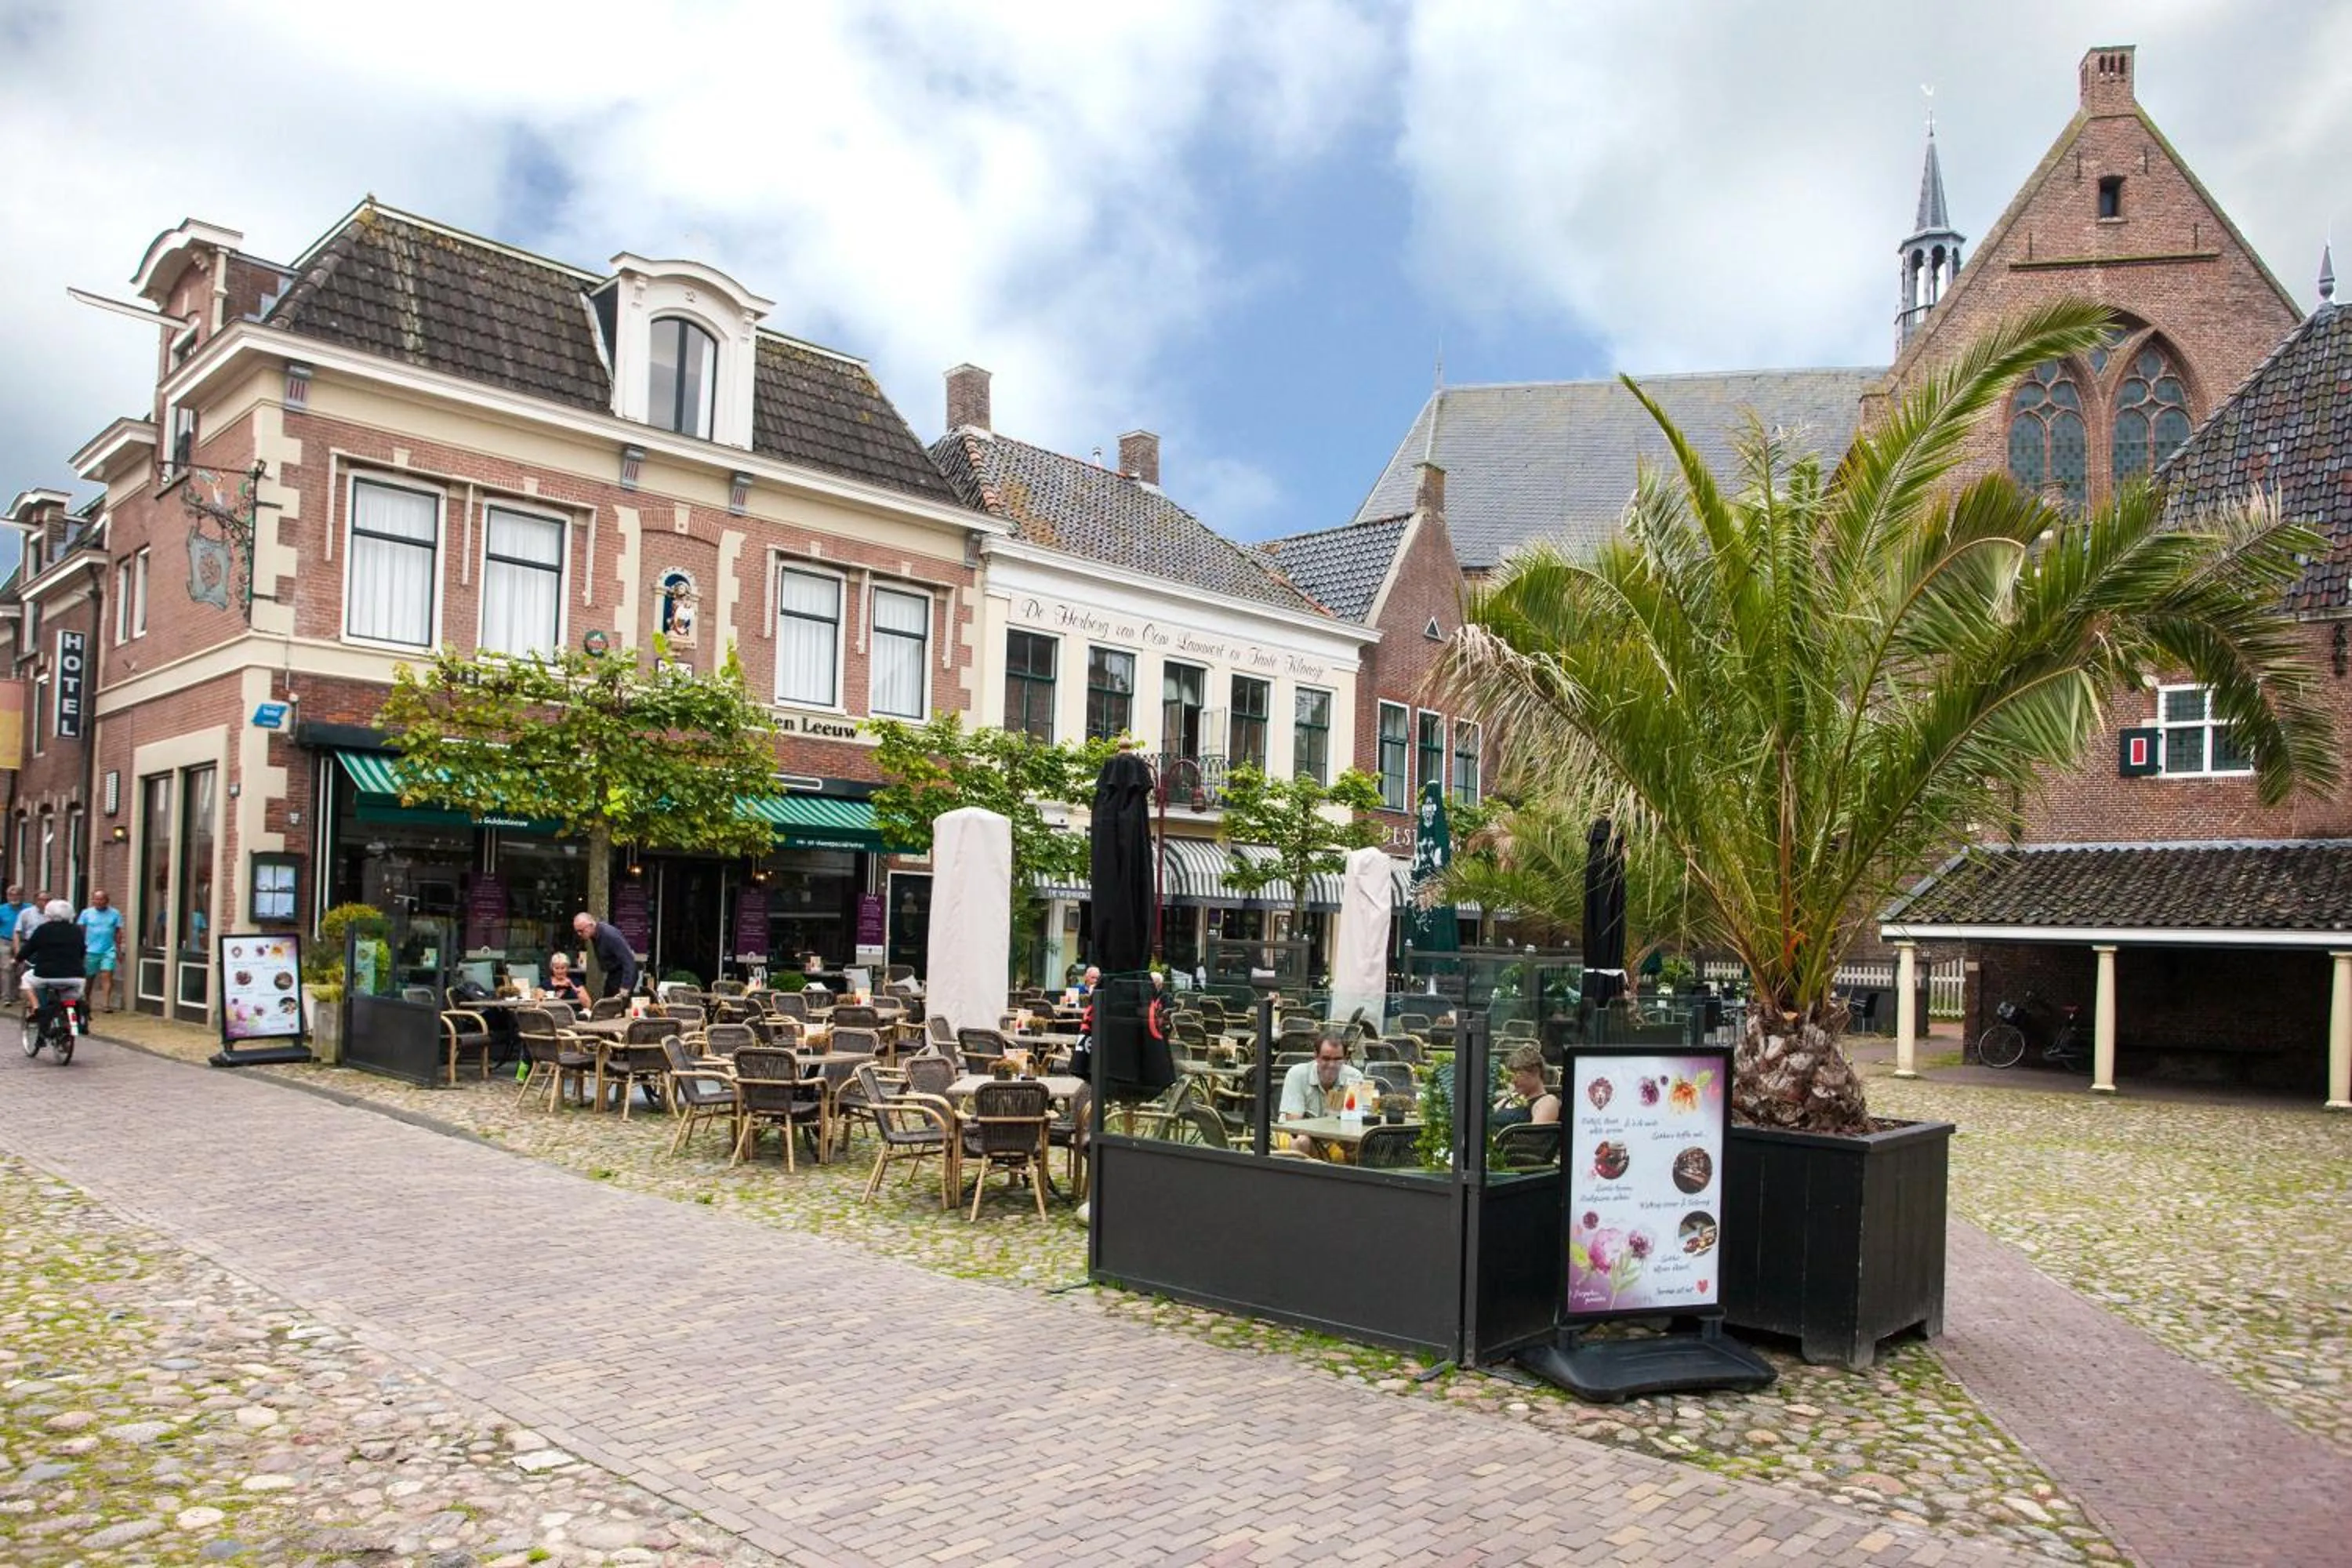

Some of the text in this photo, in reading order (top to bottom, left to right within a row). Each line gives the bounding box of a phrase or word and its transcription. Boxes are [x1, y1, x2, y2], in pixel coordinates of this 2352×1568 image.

[1022, 598, 1044, 619] De
[61, 633, 82, 736] HOTEL
[801, 717, 858, 739] Leeuw
